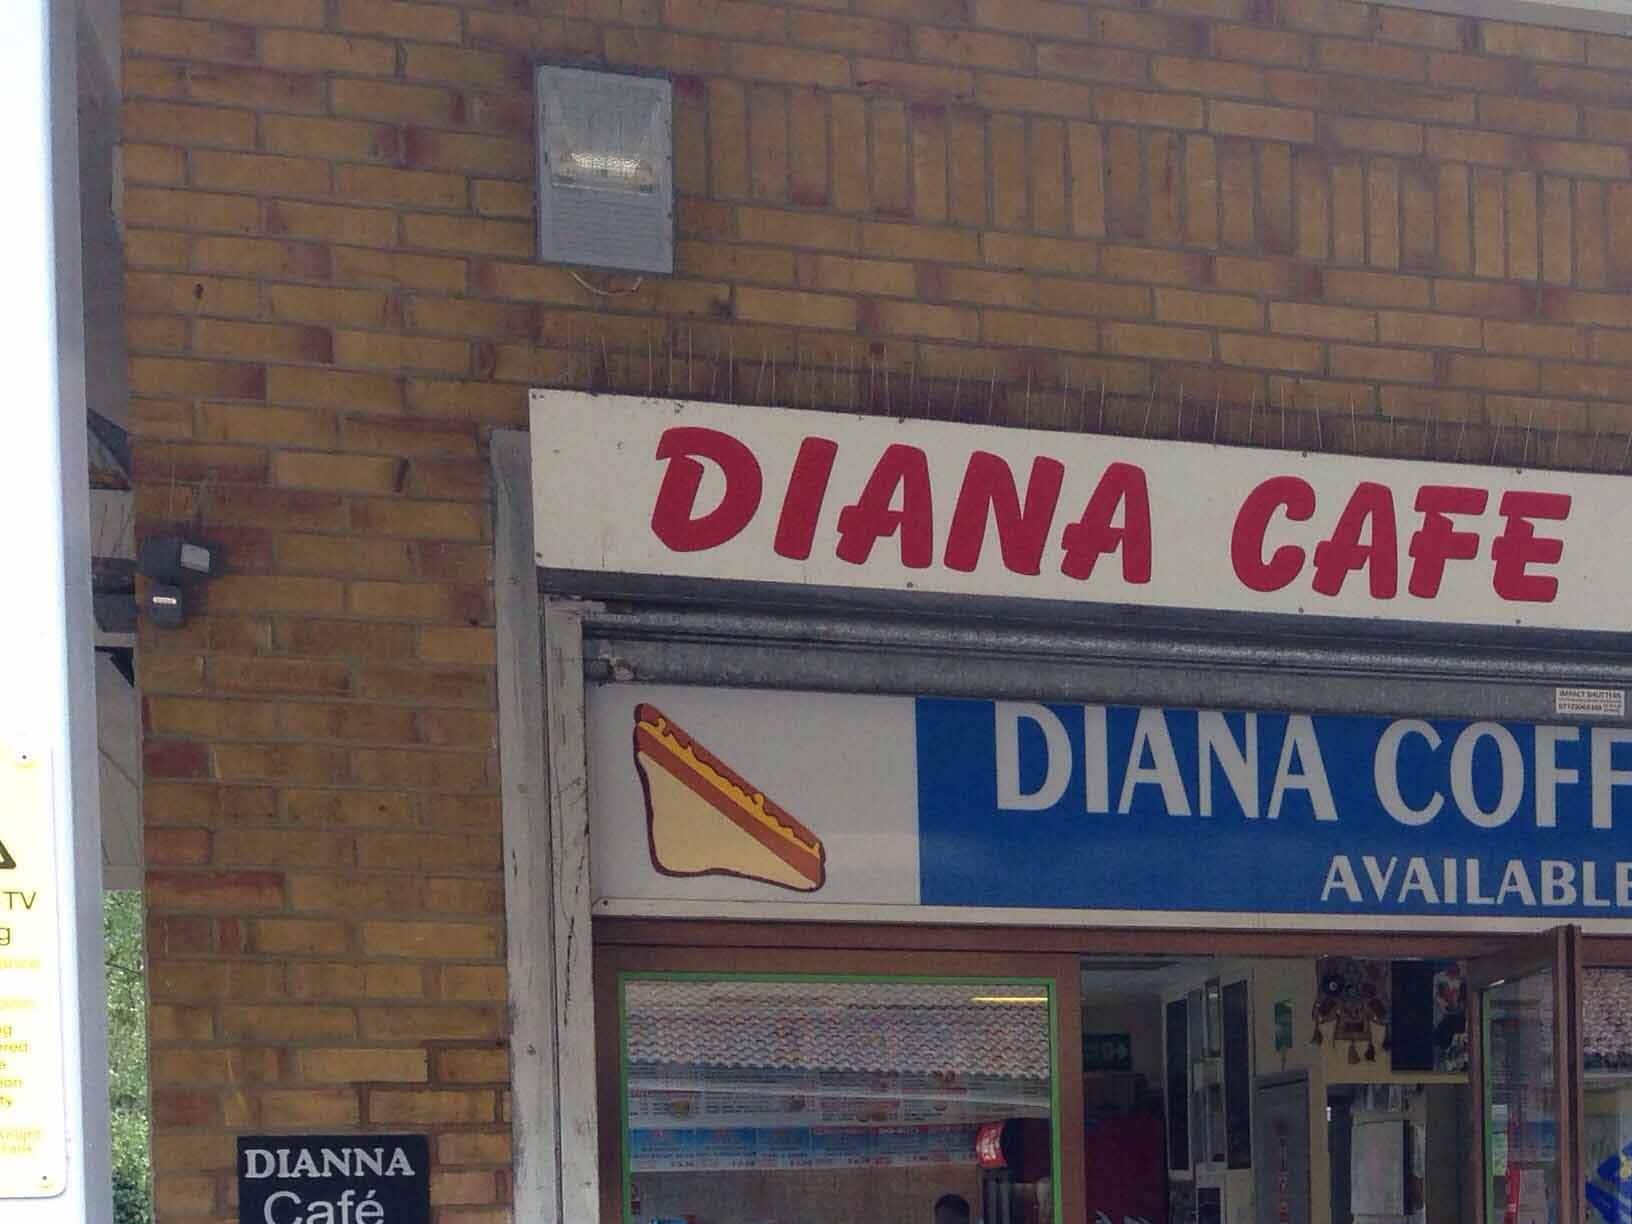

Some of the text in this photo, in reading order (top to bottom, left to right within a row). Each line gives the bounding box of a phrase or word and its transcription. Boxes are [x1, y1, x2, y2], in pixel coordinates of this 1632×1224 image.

[651, 426, 1152, 584] DIANA
[1231, 475, 1572, 603] CAFE
[995, 700, 1338, 821] DIANA
[244, 1148, 415, 1180] DIANNA
